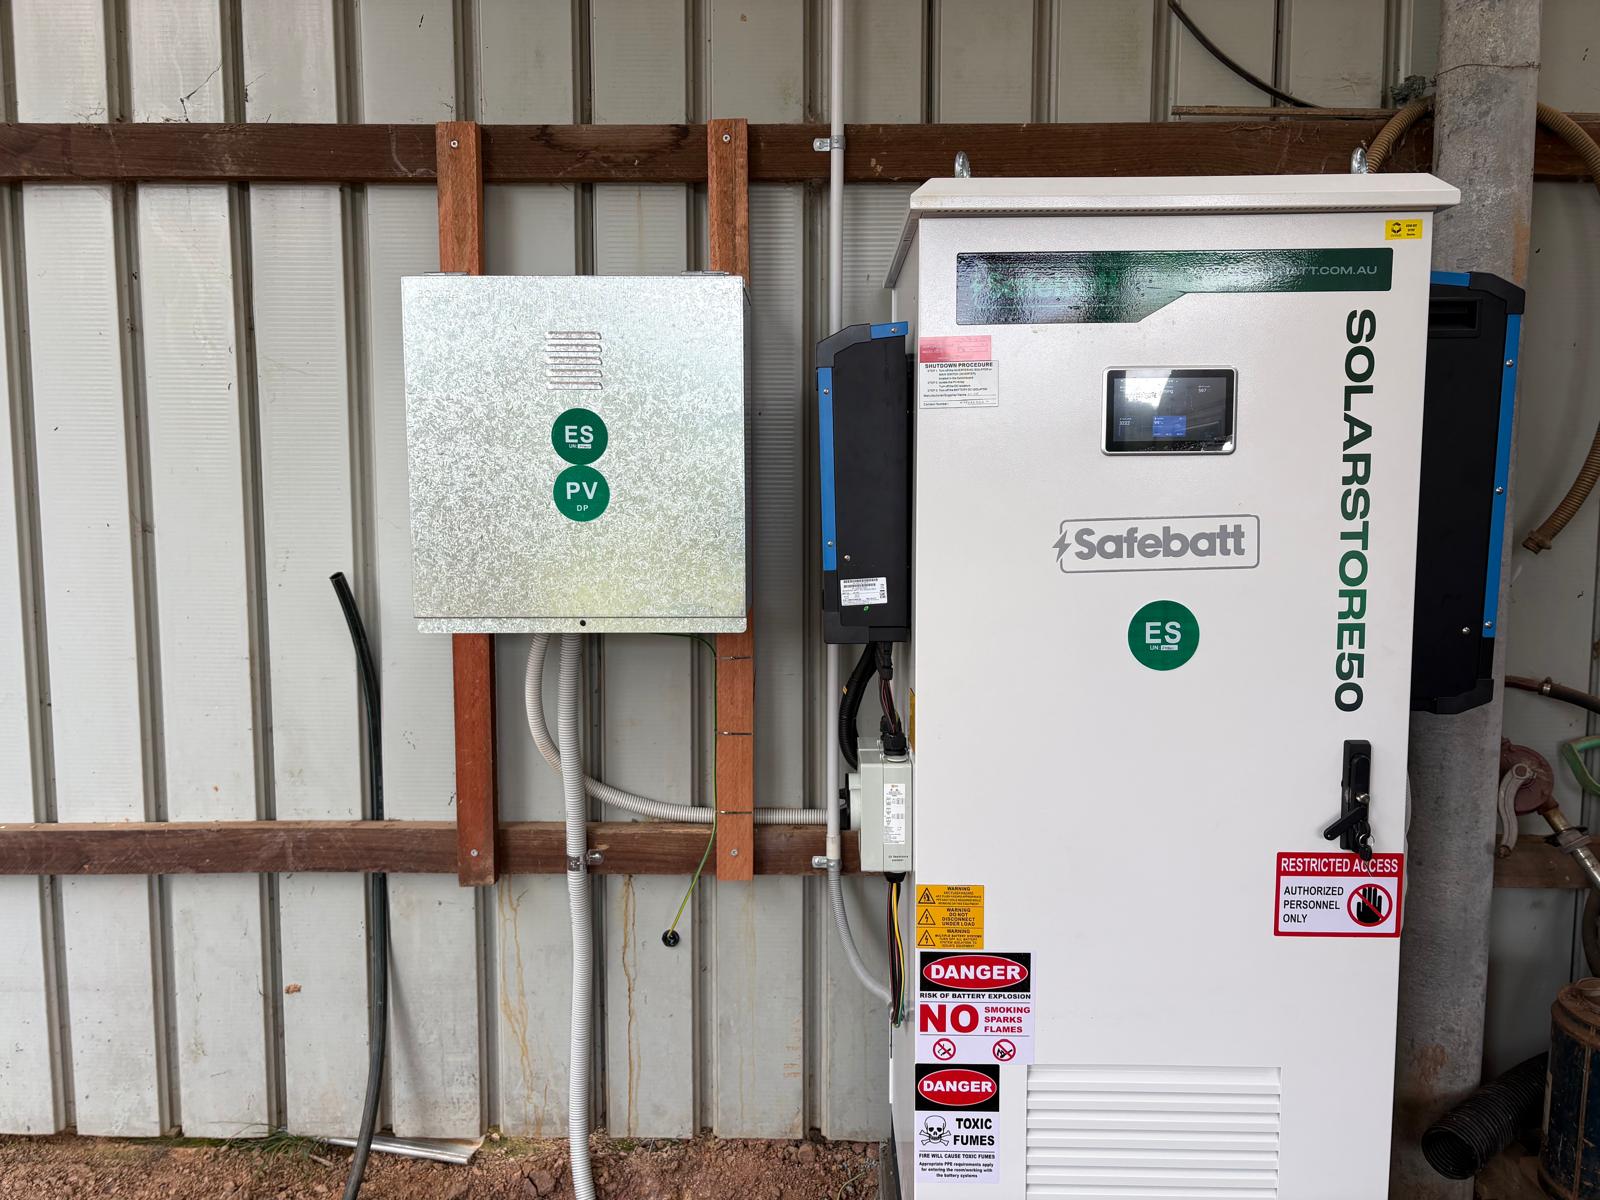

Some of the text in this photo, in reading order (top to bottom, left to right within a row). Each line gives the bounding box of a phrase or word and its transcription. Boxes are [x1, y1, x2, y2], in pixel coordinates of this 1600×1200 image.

[564, 425, 594, 443] ES
[566, 481, 598, 500] PV
[576, 504, 589, 512] DP
[1335, 308, 1377, 712] SOLARSTORE50
[1074, 524, 1245, 560] Safebatt
[1145, 621, 1181, 644] ES
[1281, 857, 1398, 873] RESTRICTED ACCESS
[1283, 886, 1344, 896] AUTHORIZED
[1283, 900, 1340, 910] PERSONNEL
[1282, 914, 1307, 923] ONLY
[930, 964, 1021, 980] DANGER
[919, 1003, 979, 1034] NO
[923, 1080, 992, 1092] DANGER
[955, 1118, 992, 1130] TOXIC
[953, 1135, 995, 1146] FUMES
